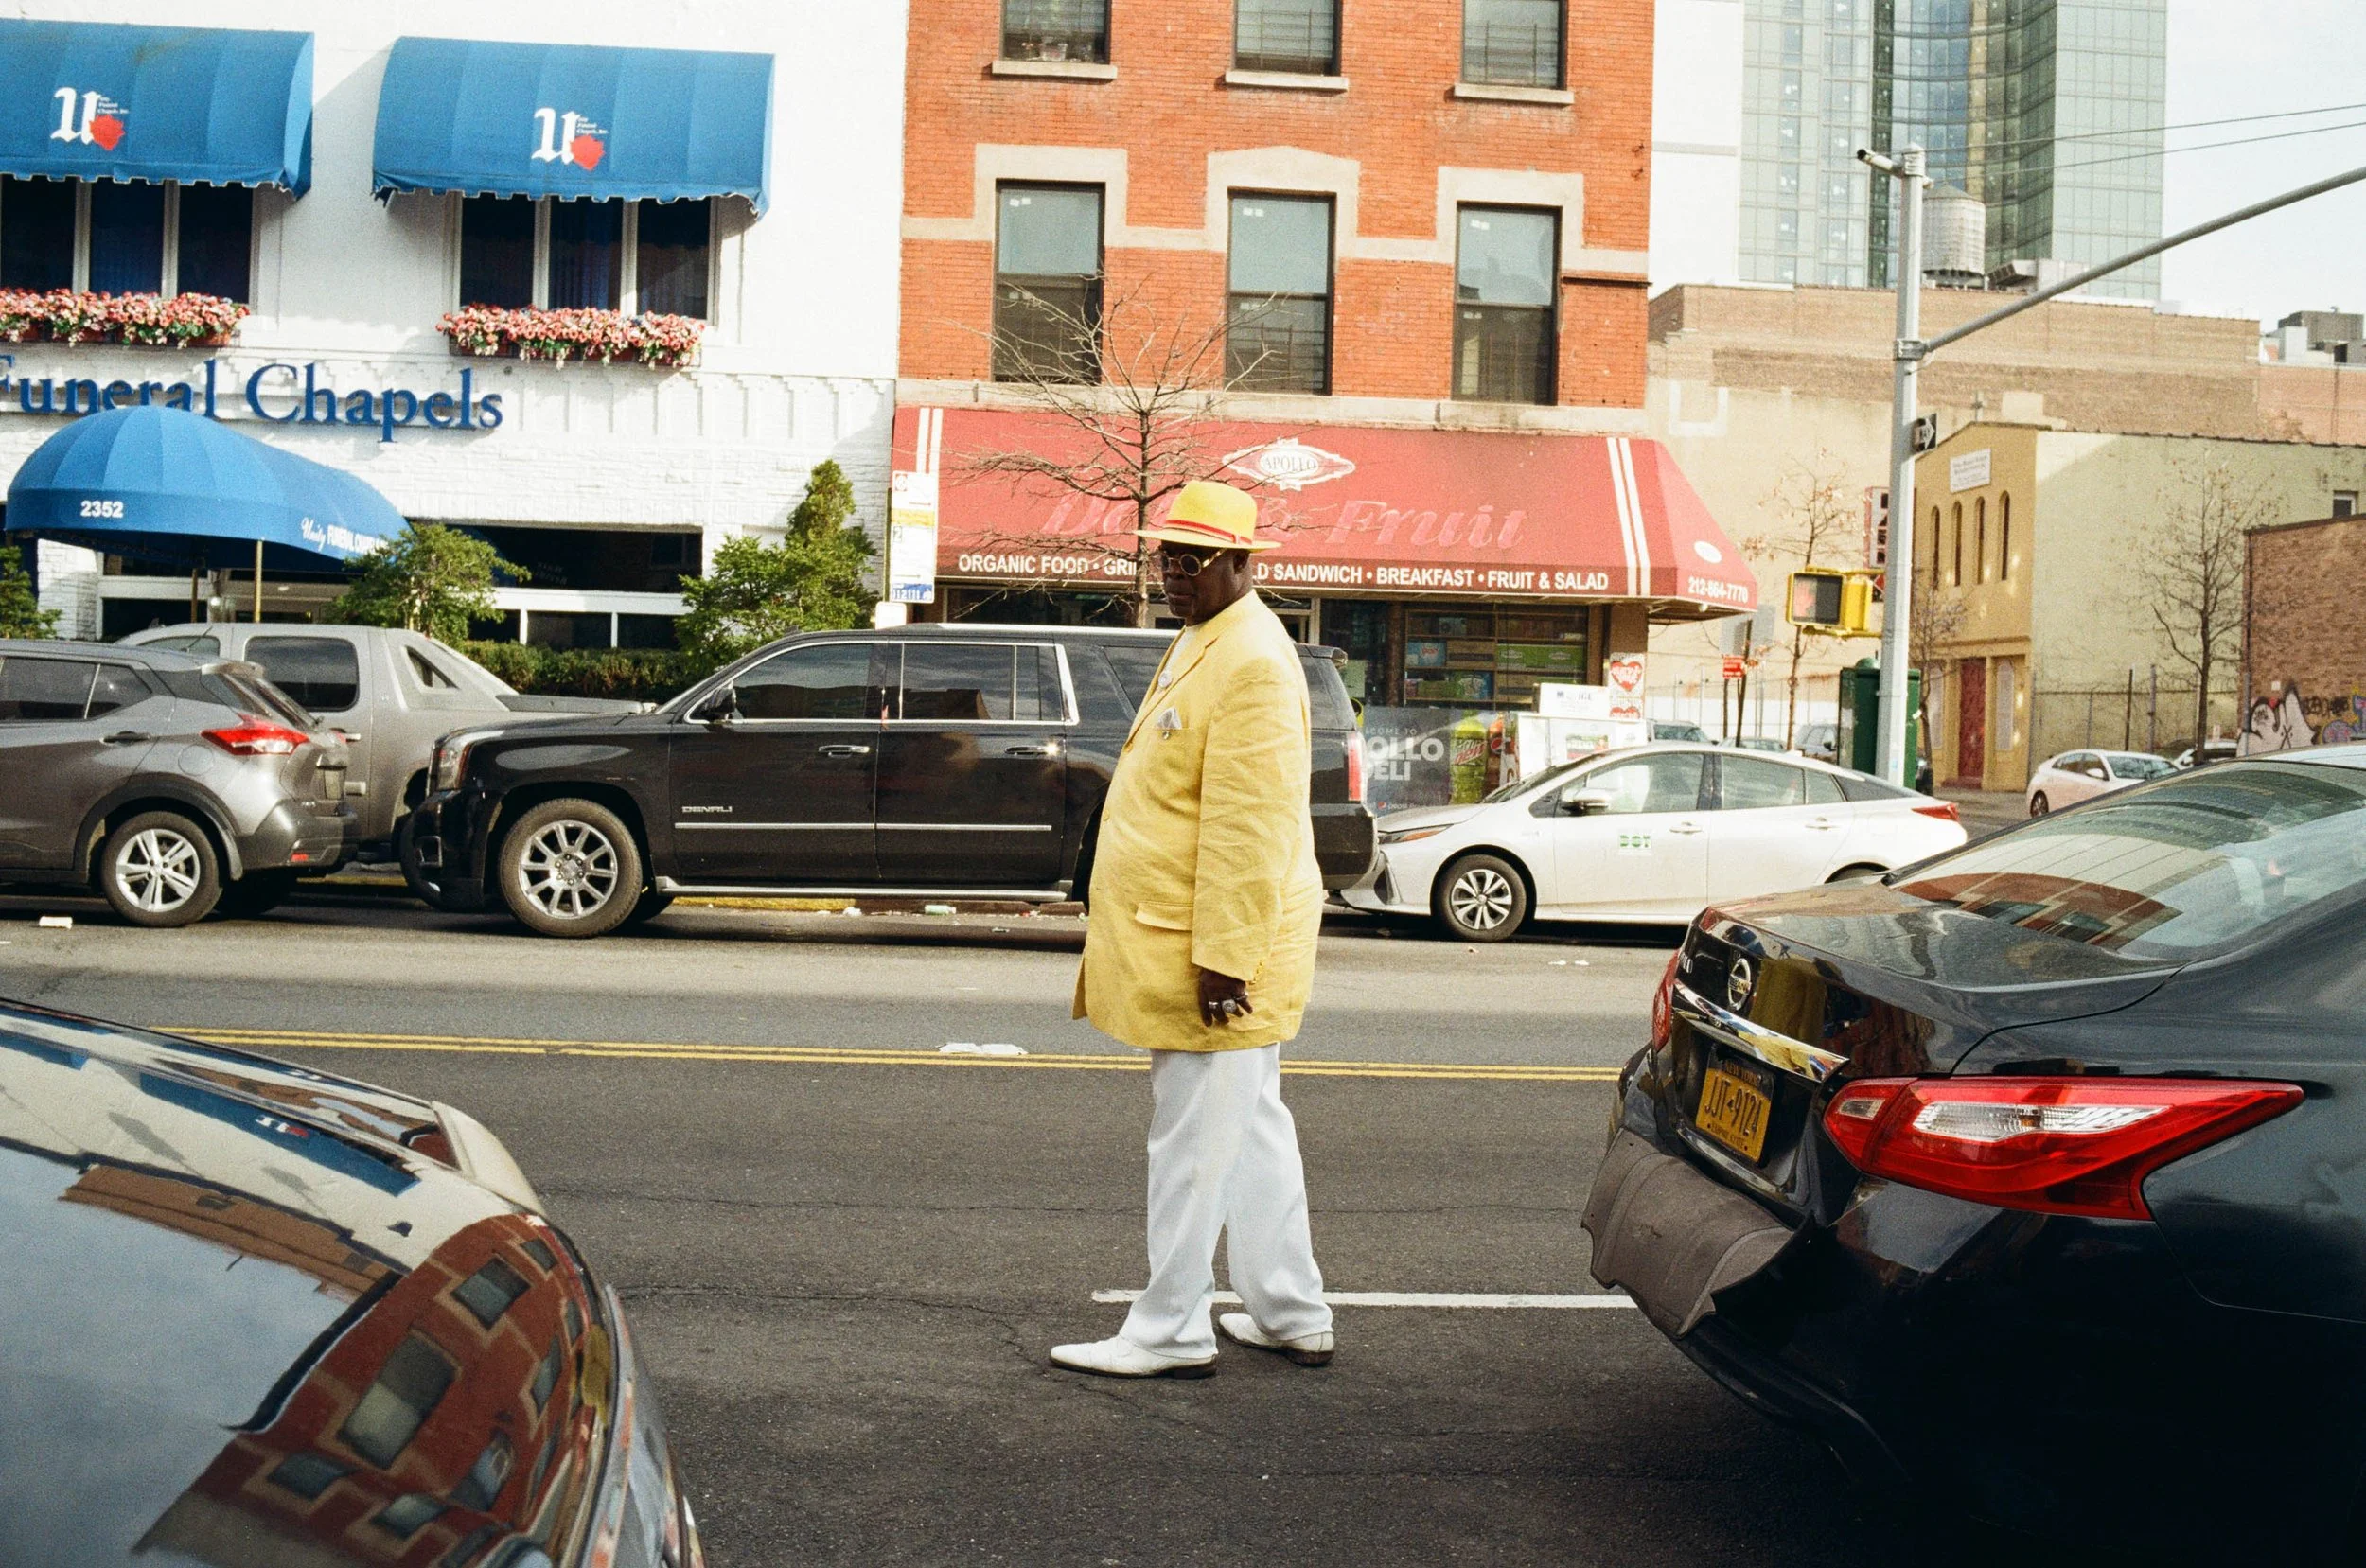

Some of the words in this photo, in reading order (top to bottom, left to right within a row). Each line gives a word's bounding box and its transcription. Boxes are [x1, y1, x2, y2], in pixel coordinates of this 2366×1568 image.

[245, 362, 503, 443] Chapels
[1264, 455, 1317, 472] APOLLO
[80, 500, 124, 518] 2352
[1324, 500, 1527, 549] Fruit
[958, 554, 1036, 573] ORGANIC
[1041, 556, 1089, 574] FOOD
[1273, 563, 1363, 585] SANDWICH
[1376, 567, 1474, 587] BREAKFAST
[1487, 570, 1535, 589] FRUIT
[1538, 572, 1551, 590] &
[1554, 573, 1609, 590] SALAD
[1365, 736, 1445, 762] OLLO
[1704, 1074, 1731, 1121] JJT
